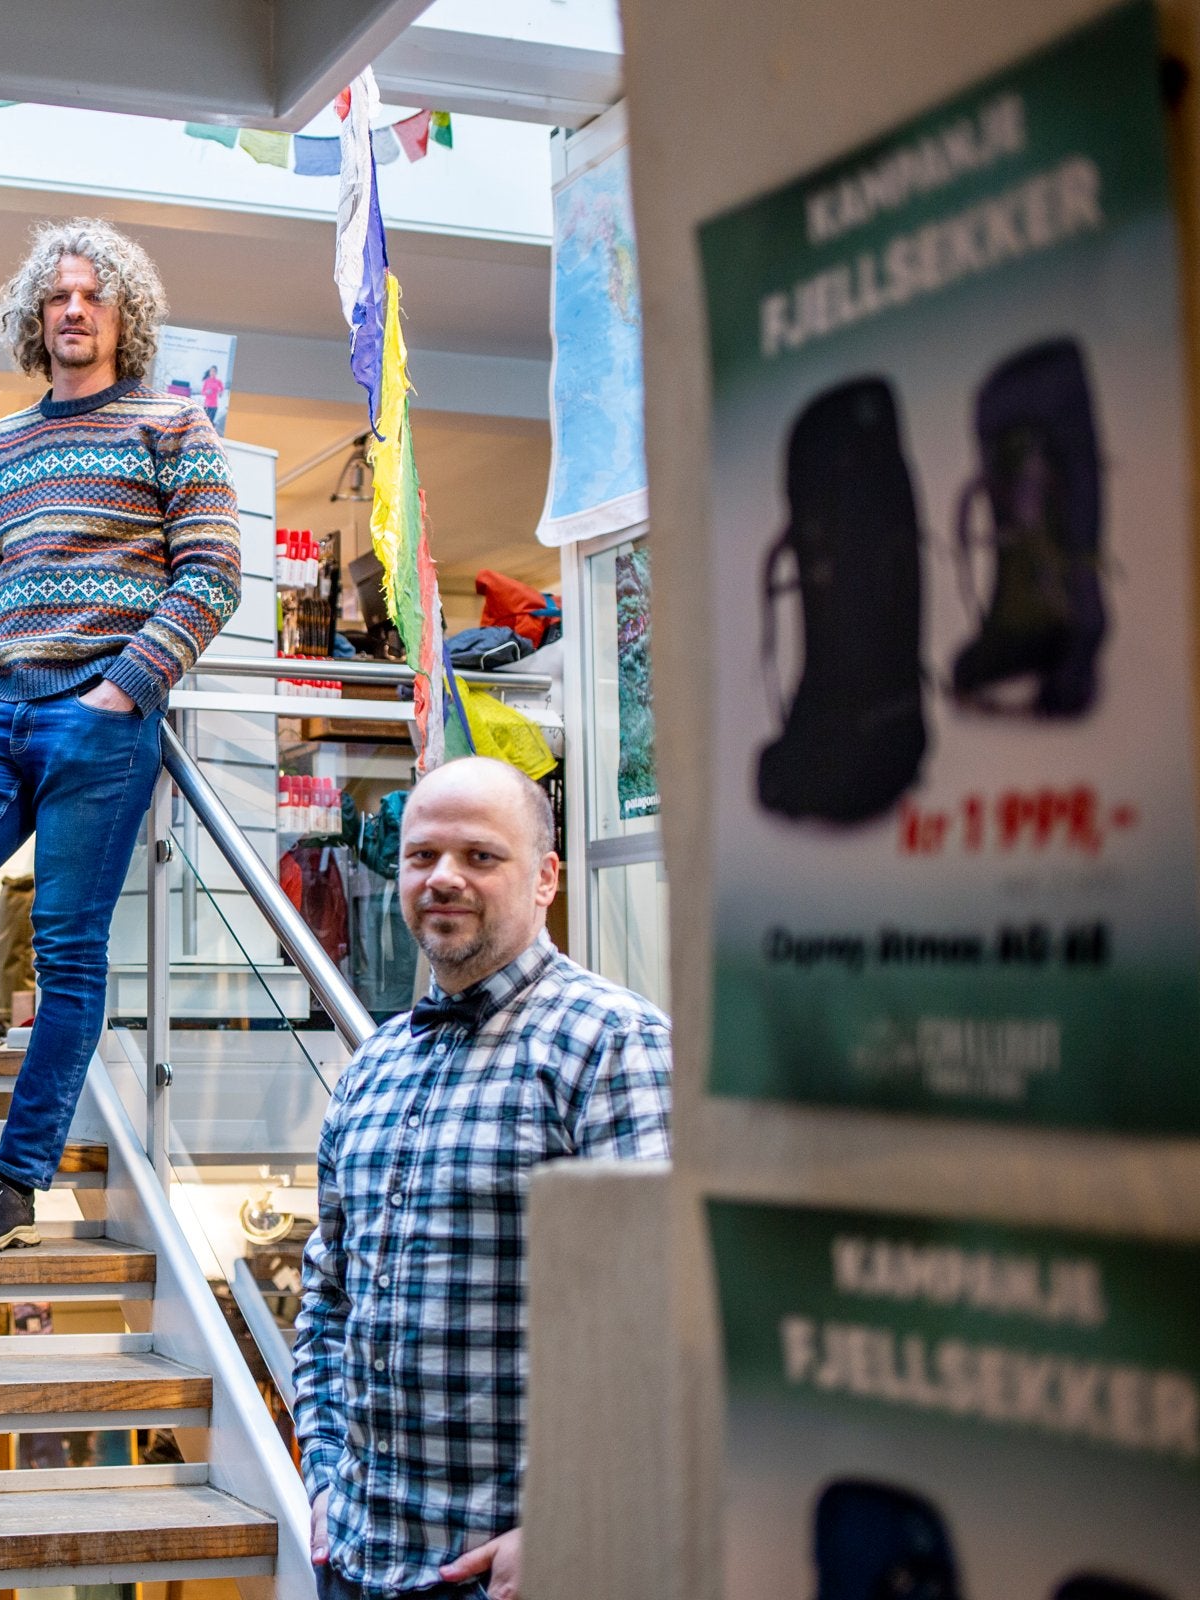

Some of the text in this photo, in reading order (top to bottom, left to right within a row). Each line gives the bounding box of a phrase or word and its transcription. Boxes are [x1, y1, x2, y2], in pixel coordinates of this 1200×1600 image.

[806, 93, 1026, 245] KAMPANJE
[761, 155, 1100, 357] FJELLSEKKER
[831, 1236, 1105, 1327] KAMPANJE
[781, 1315, 1200, 1458] FJELLSEKKER
